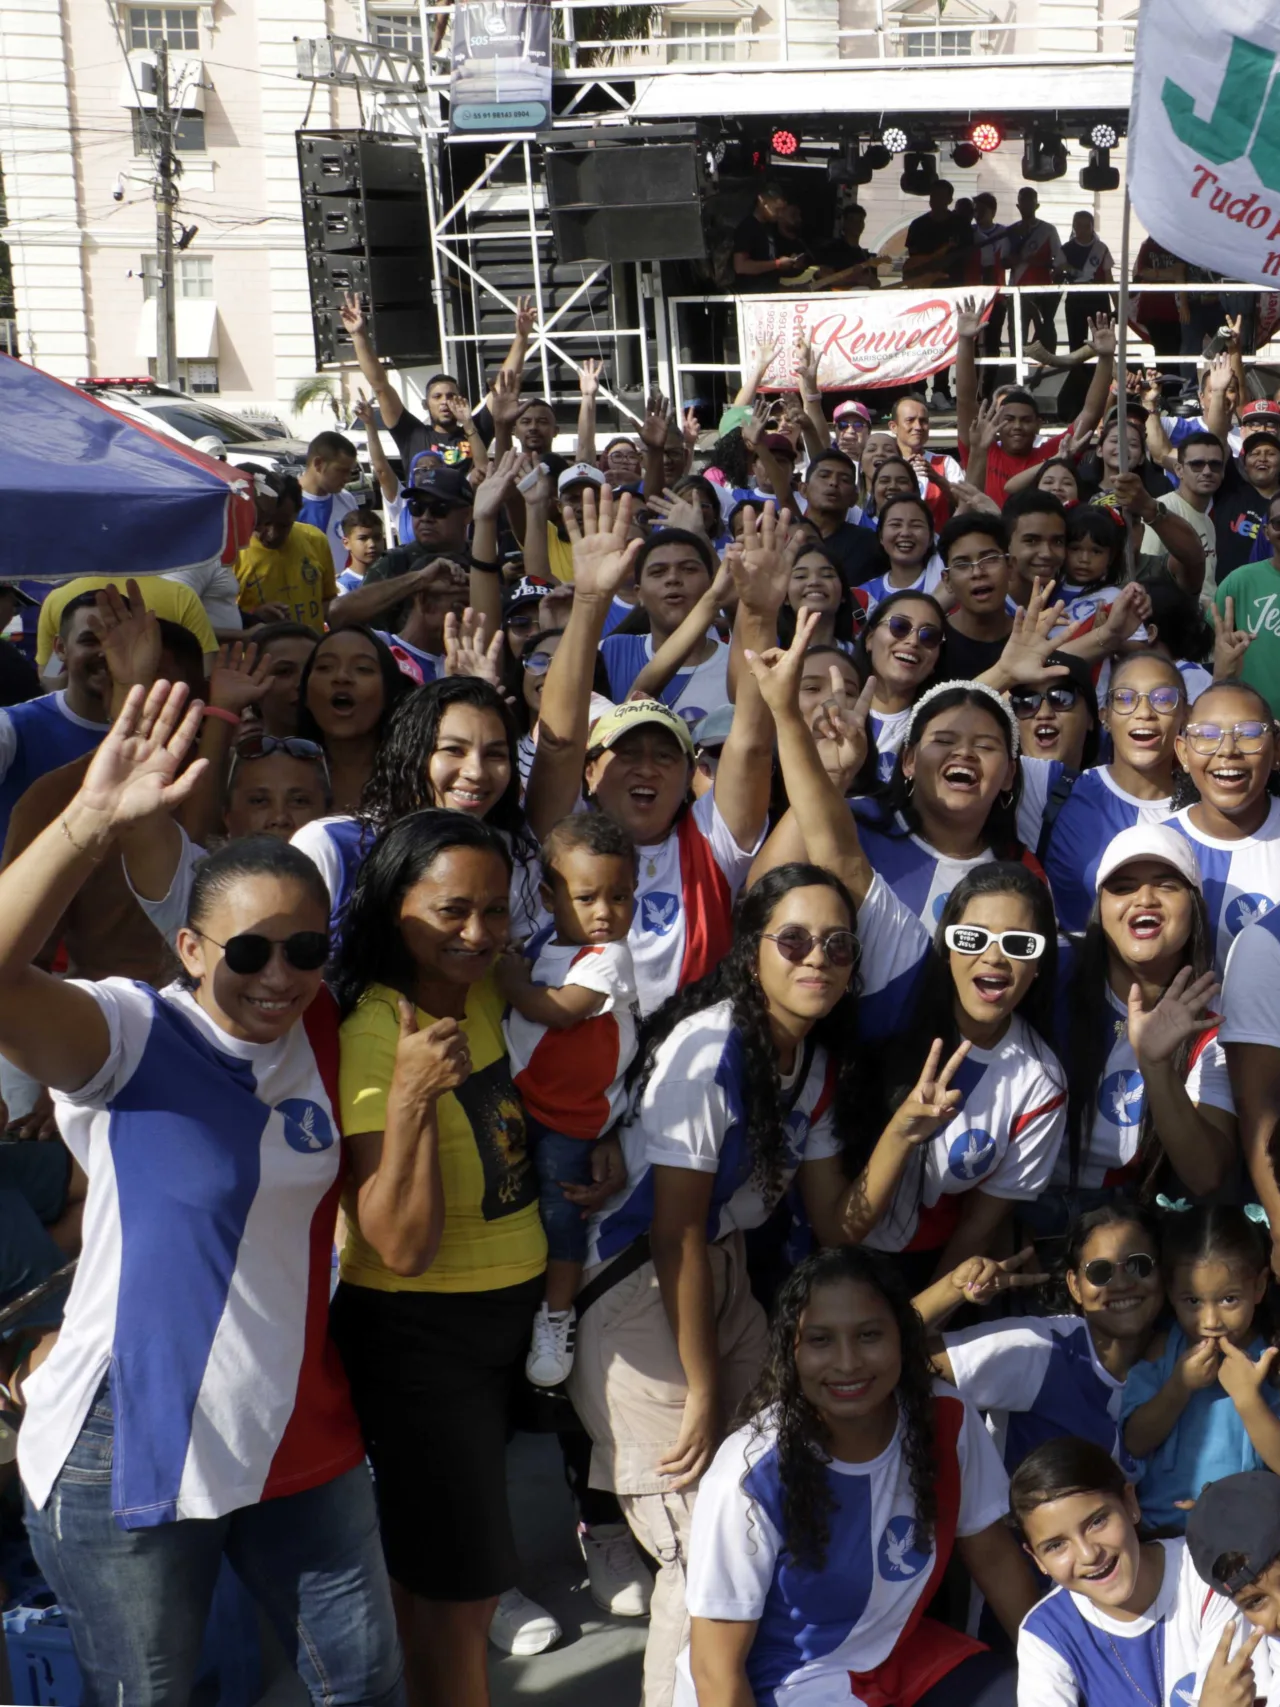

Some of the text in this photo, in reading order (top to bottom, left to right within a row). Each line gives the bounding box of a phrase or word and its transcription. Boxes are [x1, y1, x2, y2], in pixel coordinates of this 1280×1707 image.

[471, 35, 489, 46] SOS
[1190, 164, 1271, 229] Tudo
[789, 302, 809, 378] Deliery
[811, 299, 960, 373] Kennedy
[852, 352, 893, 363] MARISCOS
[901, 347, 945, 359] PESCADOS
[1230, 513, 1261, 539] Jes
[511, 585, 554, 600] JER
